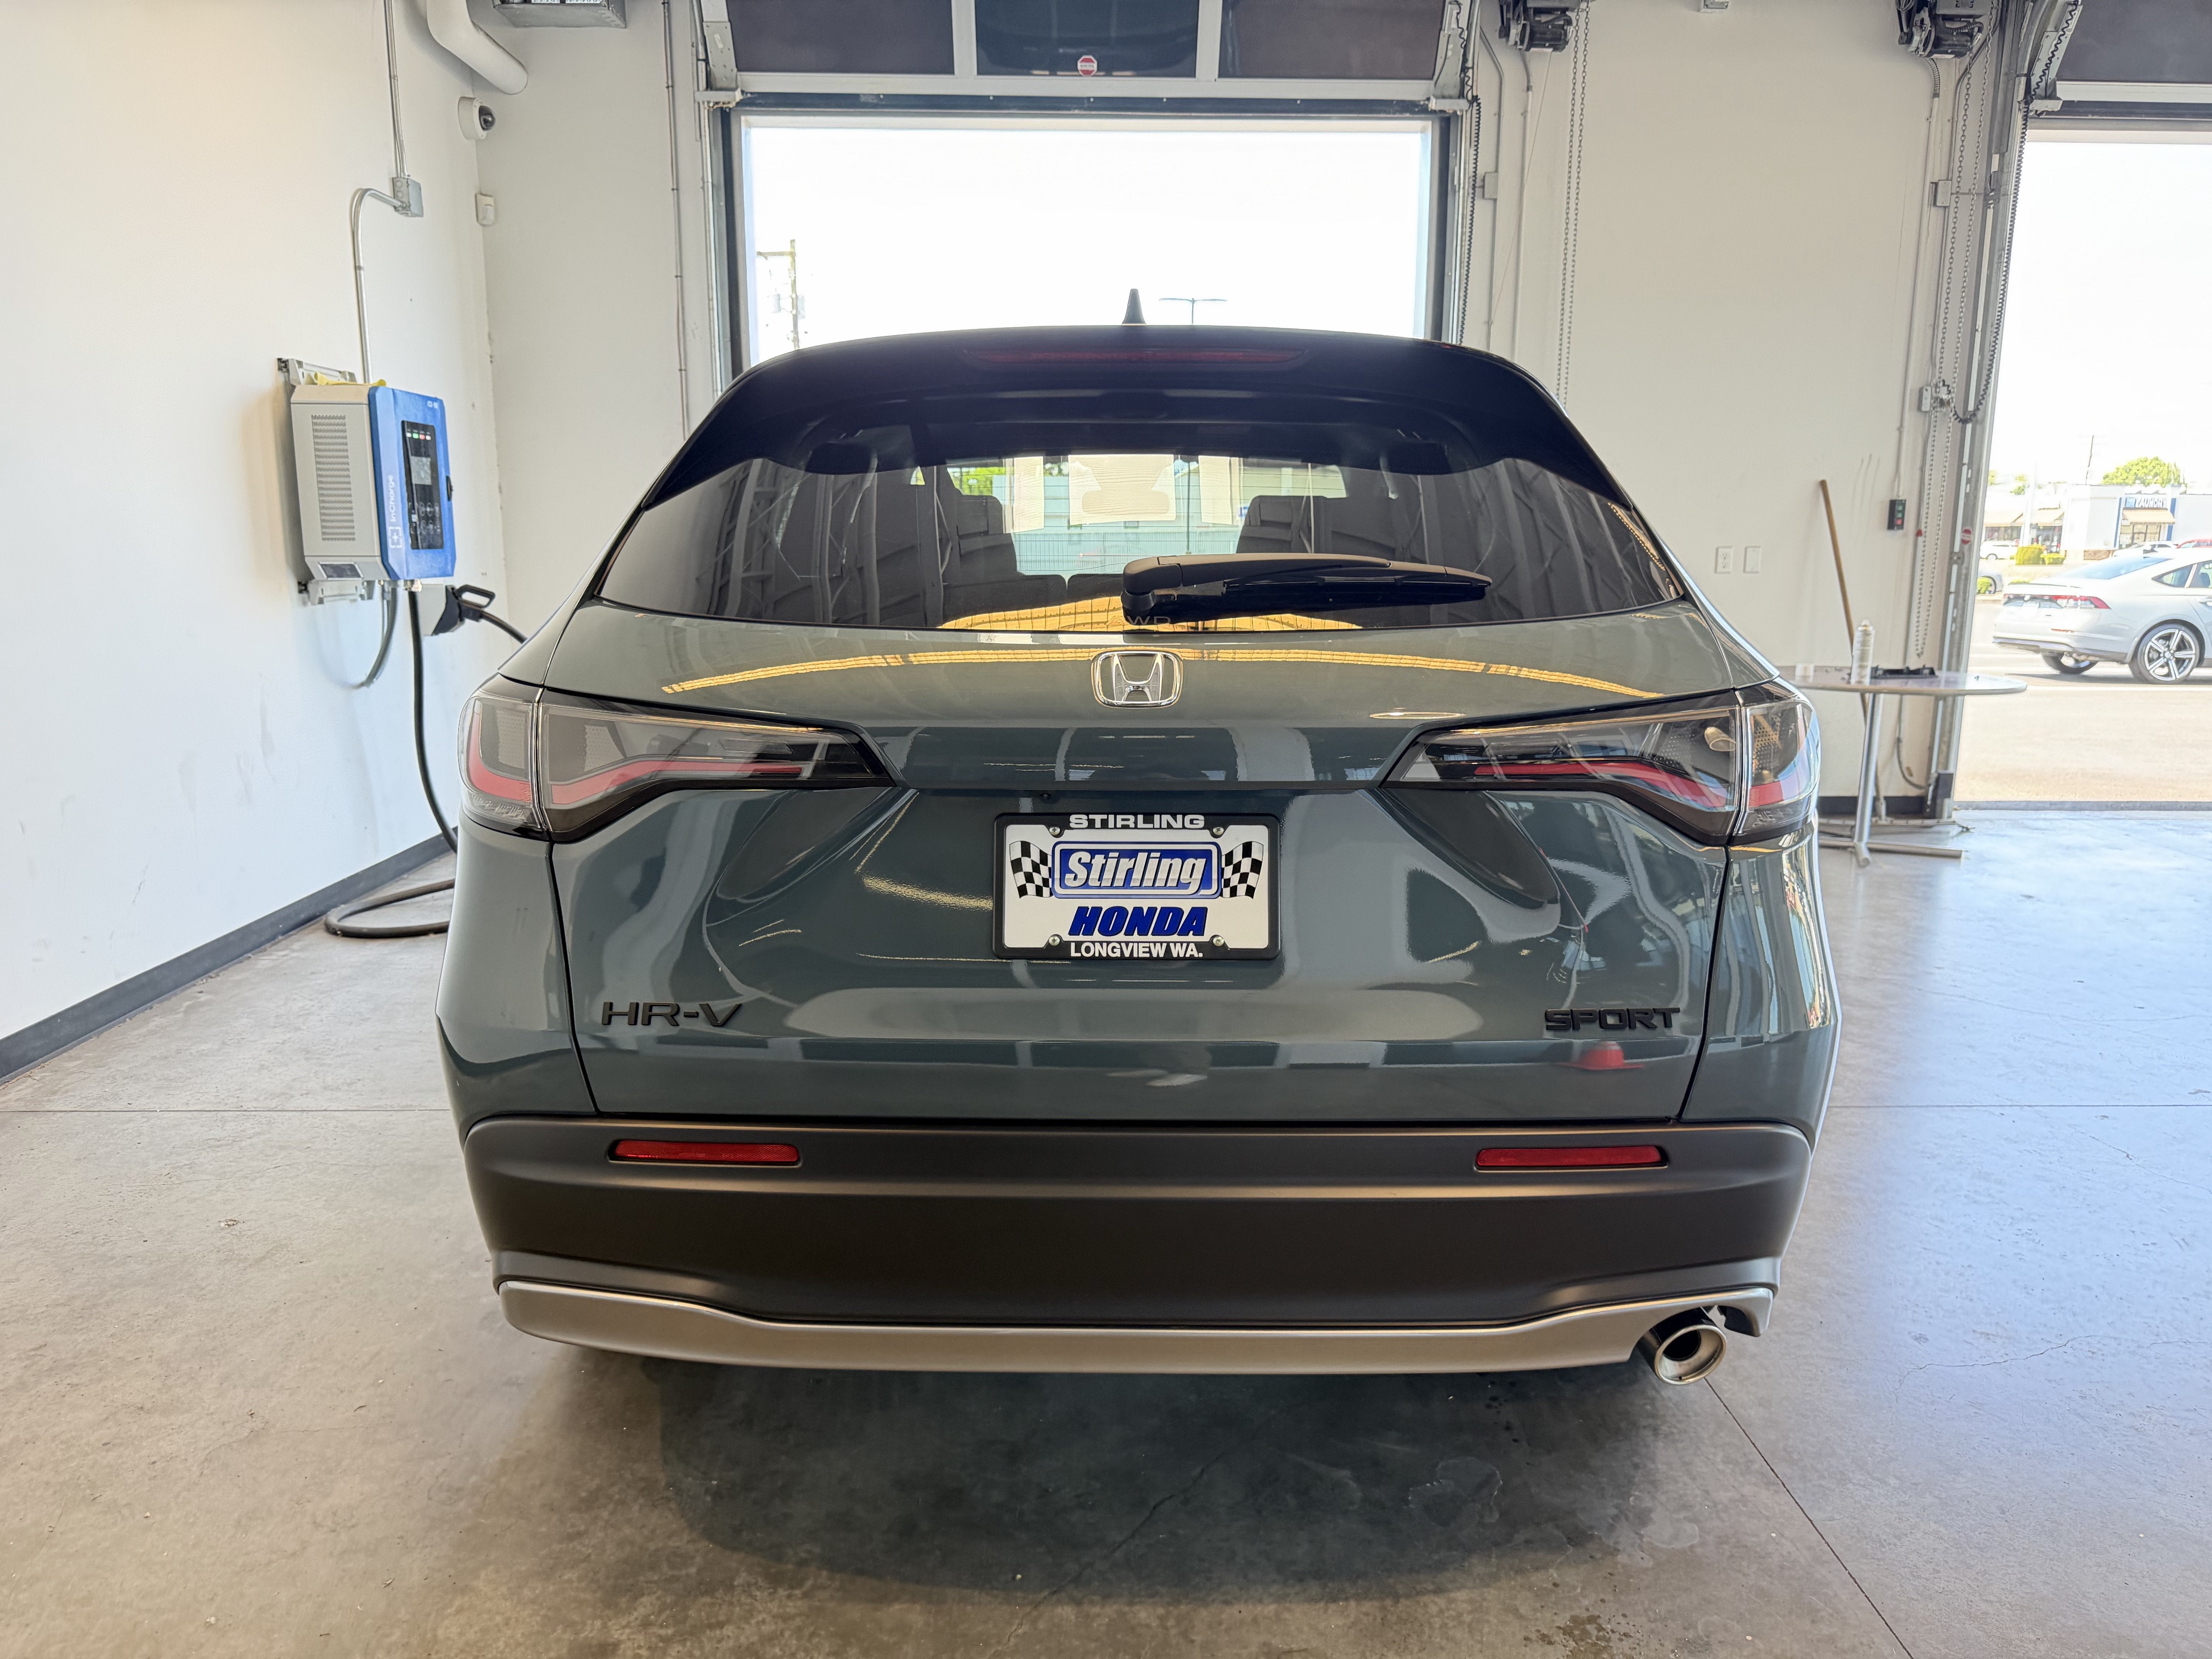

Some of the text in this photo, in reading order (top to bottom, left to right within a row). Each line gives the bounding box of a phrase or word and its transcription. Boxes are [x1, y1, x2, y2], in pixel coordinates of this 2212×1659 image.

[1070, 814, 1205, 828] STIRLING
[1065, 851, 1206, 895] Stirling
[1068, 906, 1208, 936] HONDA
[1071, 942, 1203, 957] LONGVIEW WA.
[601, 1002, 742, 1027] HR-V
[1545, 1007, 1681, 1030] SPORT
